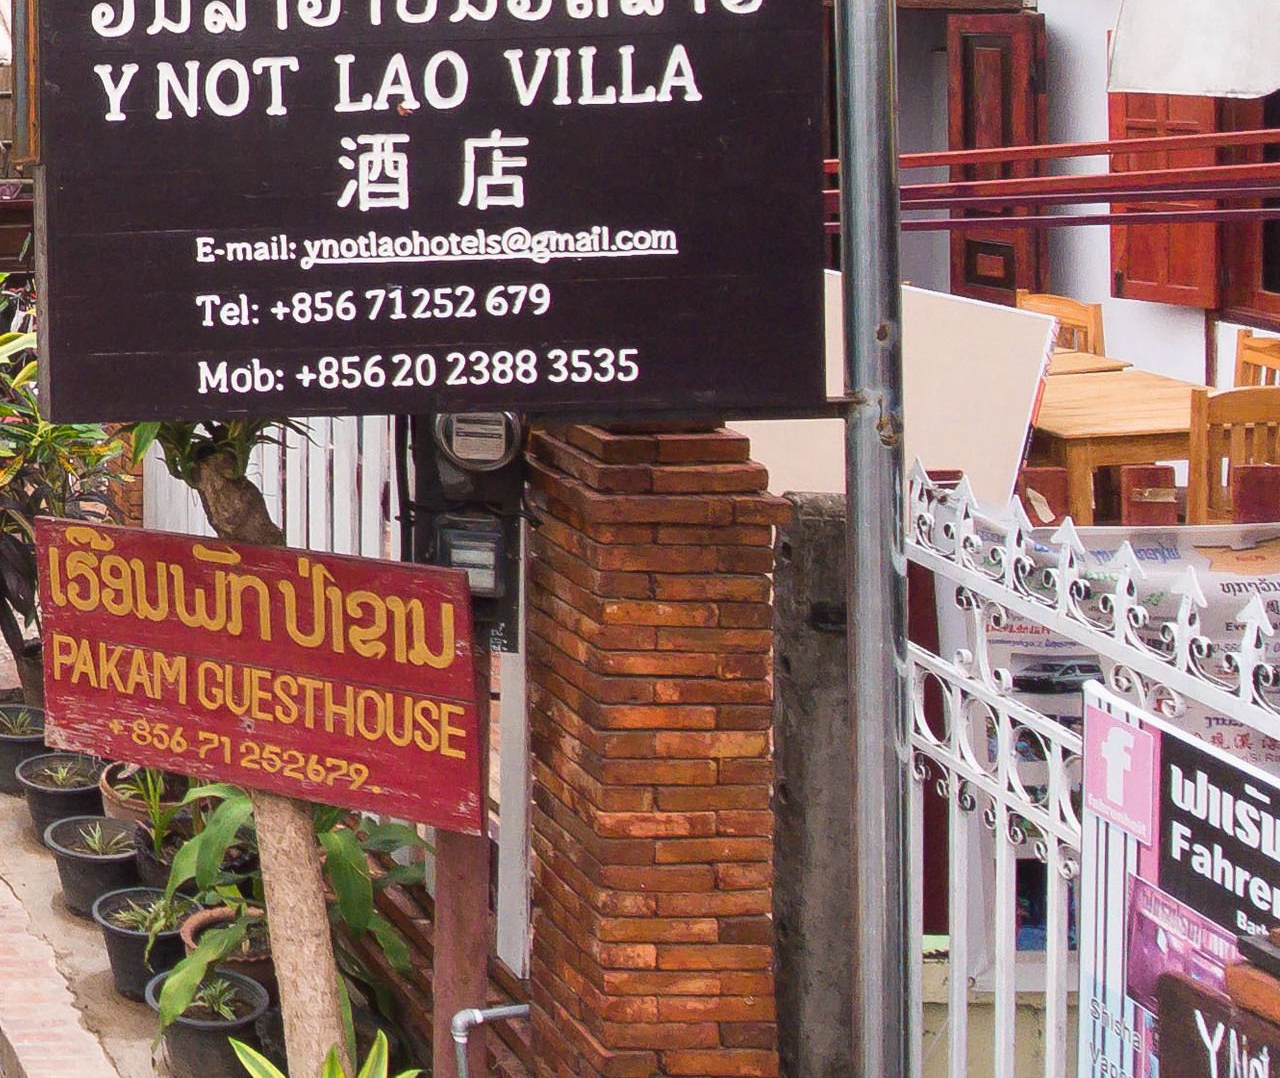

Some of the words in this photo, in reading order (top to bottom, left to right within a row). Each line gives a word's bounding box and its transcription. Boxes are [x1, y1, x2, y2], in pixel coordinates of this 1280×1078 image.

[94, 63, 140, 122] Y
[155, 55, 301, 120] NOT
[334, 51, 470, 114] LAO
[503, 44, 703, 108] VILLA
[195, 235, 297, 264] E-mail:
[300, 225, 679, 270] ynotlaohotels@gmail.com
[195, 295, 260, 328] Tel:
[270, 290, 357, 324] +856
[197, 359, 285, 394] Mob:
[295, 354, 386, 390] +856
[391, 353, 436, 387] 20
[446, 349, 538, 385] 2388
[547, 347, 639, 384] 3535
[51, 633, 188, 706] PAKAM
[197, 660, 467, 760] GUESTHOUSE
